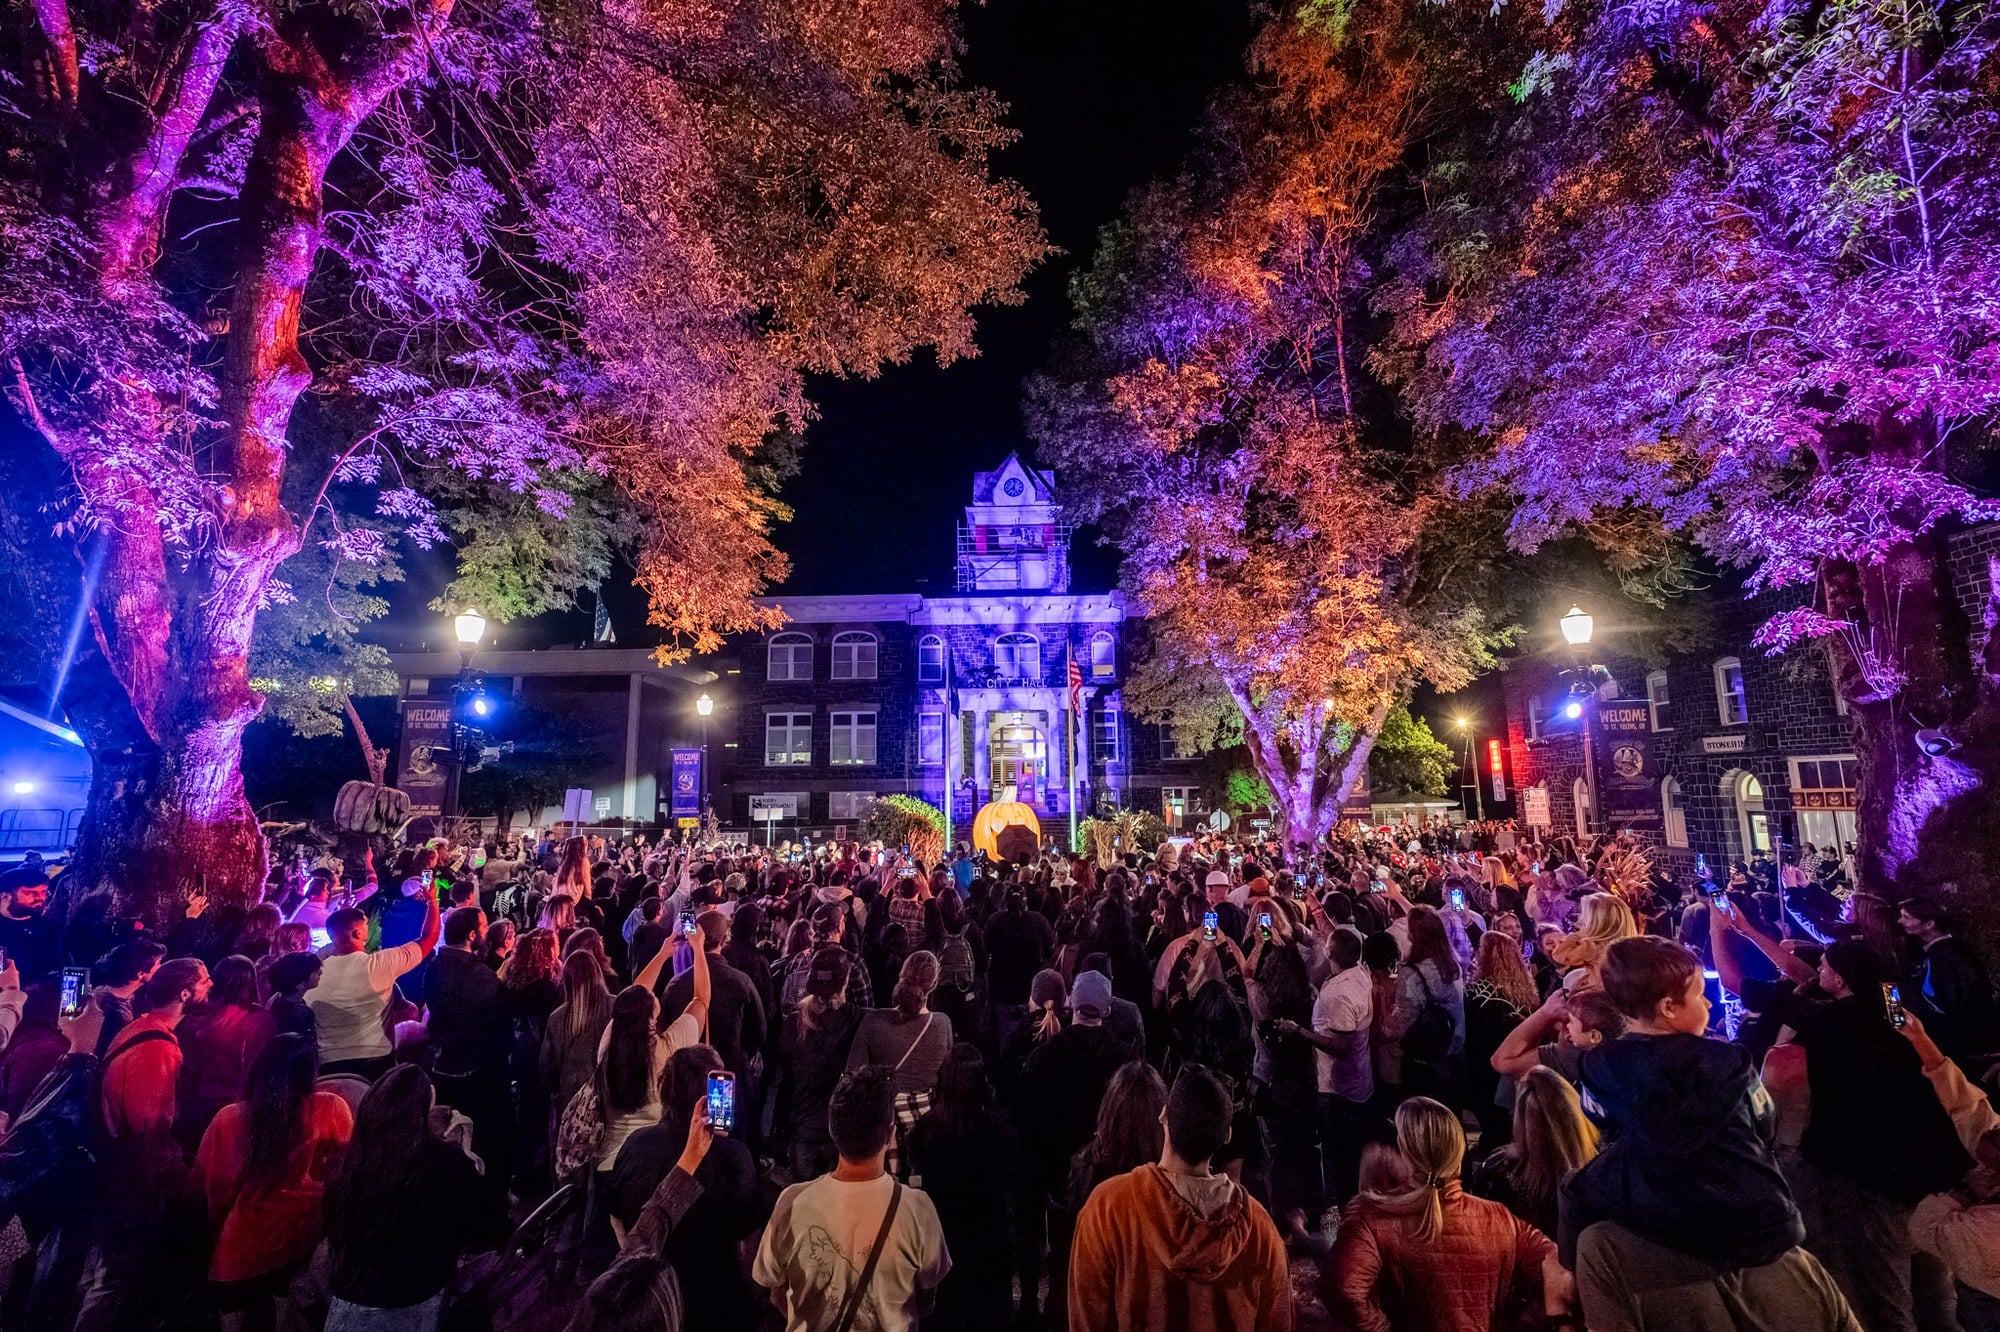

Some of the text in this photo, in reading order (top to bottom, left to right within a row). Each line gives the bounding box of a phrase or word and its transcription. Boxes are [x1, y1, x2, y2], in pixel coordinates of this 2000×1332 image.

[986, 678, 1047, 688] CITY HALL
[407, 709, 451, 721] WELCOME
[1600, 708, 1647, 723] WELCOME
[674, 753, 699, 761] WELCOME
